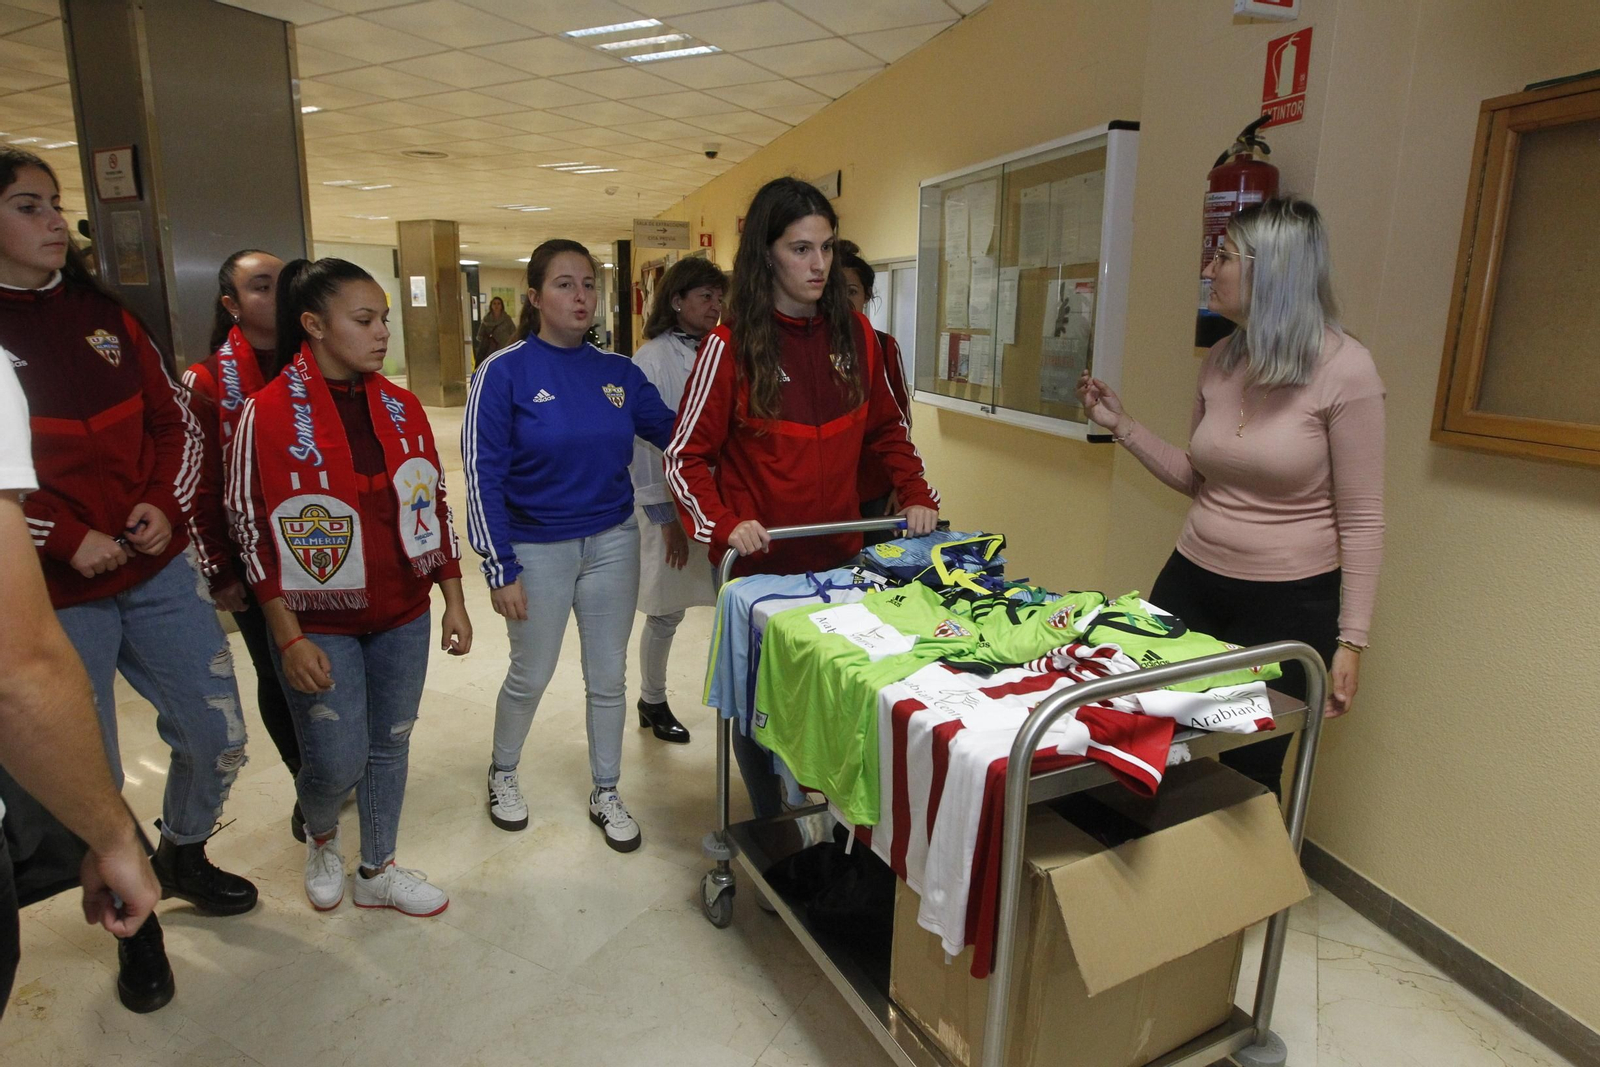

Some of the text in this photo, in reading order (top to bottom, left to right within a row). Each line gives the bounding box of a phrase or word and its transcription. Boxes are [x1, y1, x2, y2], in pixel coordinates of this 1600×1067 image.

[288, 403, 323, 467] Somos
[289, 522, 344, 533] U D
[294, 537, 345, 546] ALMERIA
[1190, 706, 1256, 728] Arabian
